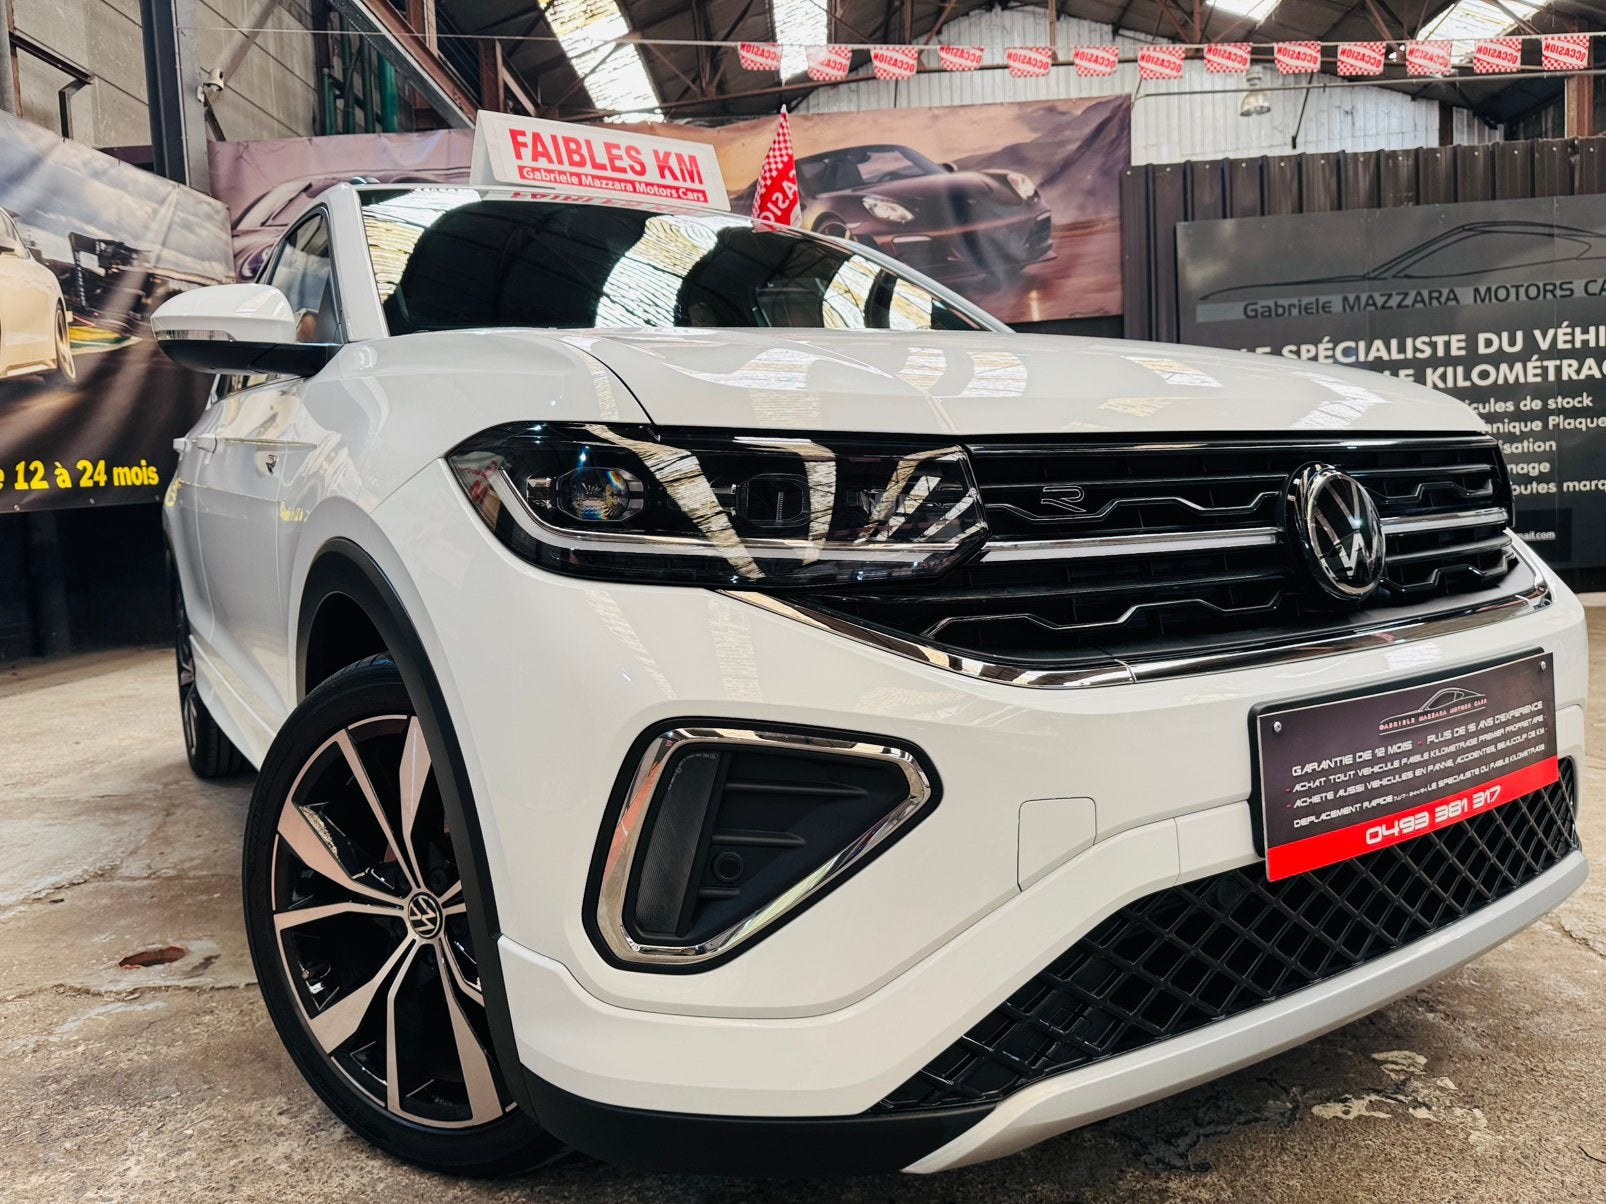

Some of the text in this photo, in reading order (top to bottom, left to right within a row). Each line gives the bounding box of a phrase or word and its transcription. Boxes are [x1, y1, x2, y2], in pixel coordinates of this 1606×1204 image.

[508, 128, 704, 185] FAIBLES KM
[523, 167, 705, 202] Gabriele Mazzara Motors Cars
[1243, 298, 1332, 319] Gabriele
[1342, 288, 1460, 314] MAZZARA
[1473, 279, 1574, 304] MOTORS
[1281, 321, 1606, 364] SPÉCIALISTE DU VÉHI
[1425, 354, 1606, 388] KILOMÉTRA
[1519, 395, 1542, 411] de
[1547, 392, 1593, 409] stock
[1548, 415, 1606, 431] Plaque
[14, 460, 49, 490] 12
[54, 461, 72, 488] à
[76, 459, 107, 487] 24
[112, 459, 160, 486] mois
[1292, 754, 1353, 776] GARANTIE
[1356, 750, 1373, 762] DE
[1375, 747, 1385, 757] 12
[1388, 740, 1413, 755] MOIS
[1427, 729, 1452, 745] PLUS
[1453, 726, 1466, 737] DE
[1467, 722, 1476, 733] 15
[1478, 717, 1494, 730] ANS
[1293, 777, 1326, 793] ACHAT
[1329, 771, 1356, 783] TOUT
[1357, 759, 1400, 777] VEHICULE
[1401, 752, 1429, 767] FAIBLE
[1430, 739, 1478, 758] KILOMETRAGE
[1479, 728, 1505, 743] PREMIER
[1293, 791, 1334, 809] ACHETE
[1336, 783, 1365, 798] AUSSI
[1366, 770, 1414, 790] VEHICULES
[1414, 767, 1427, 777] EN
[1496, 733, 1527, 750] BEAUCOUP
[1528, 730, 1536, 739] DE
[1536, 727, 1545, 736] KM
[1293, 803, 1361, 828] DEPLACEMENT
[1362, 795, 1394, 810] RAPIDE
[1427, 781, 1437, 791] LE
[1438, 768, 1480, 787] SPECIALISTE
[1480, 764, 1489, 773] DU
[1490, 757, 1509, 770] FAIBLE
[1509, 743, 1545, 762] KILOMETRAGE
[1366, 785, 1502, 845] 0493 381 317
